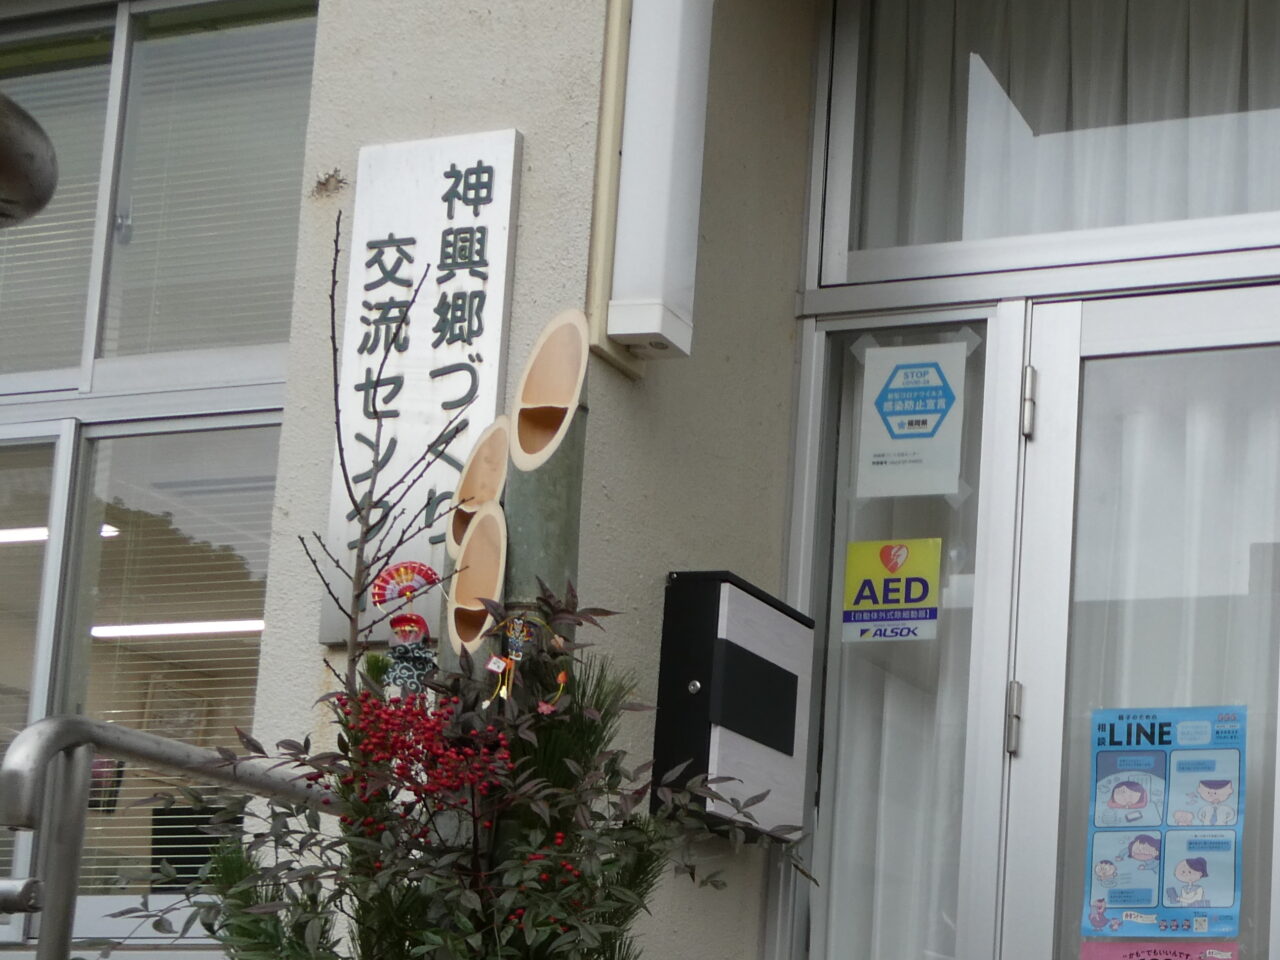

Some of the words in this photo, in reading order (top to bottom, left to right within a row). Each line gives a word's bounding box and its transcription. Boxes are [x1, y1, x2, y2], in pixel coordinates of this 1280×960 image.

[904, 370, 929, 380] STOP
[853, 577, 929, 605] AED
[872, 626, 918, 638] ALSOK
[1109, 722, 1172, 746] LINE
